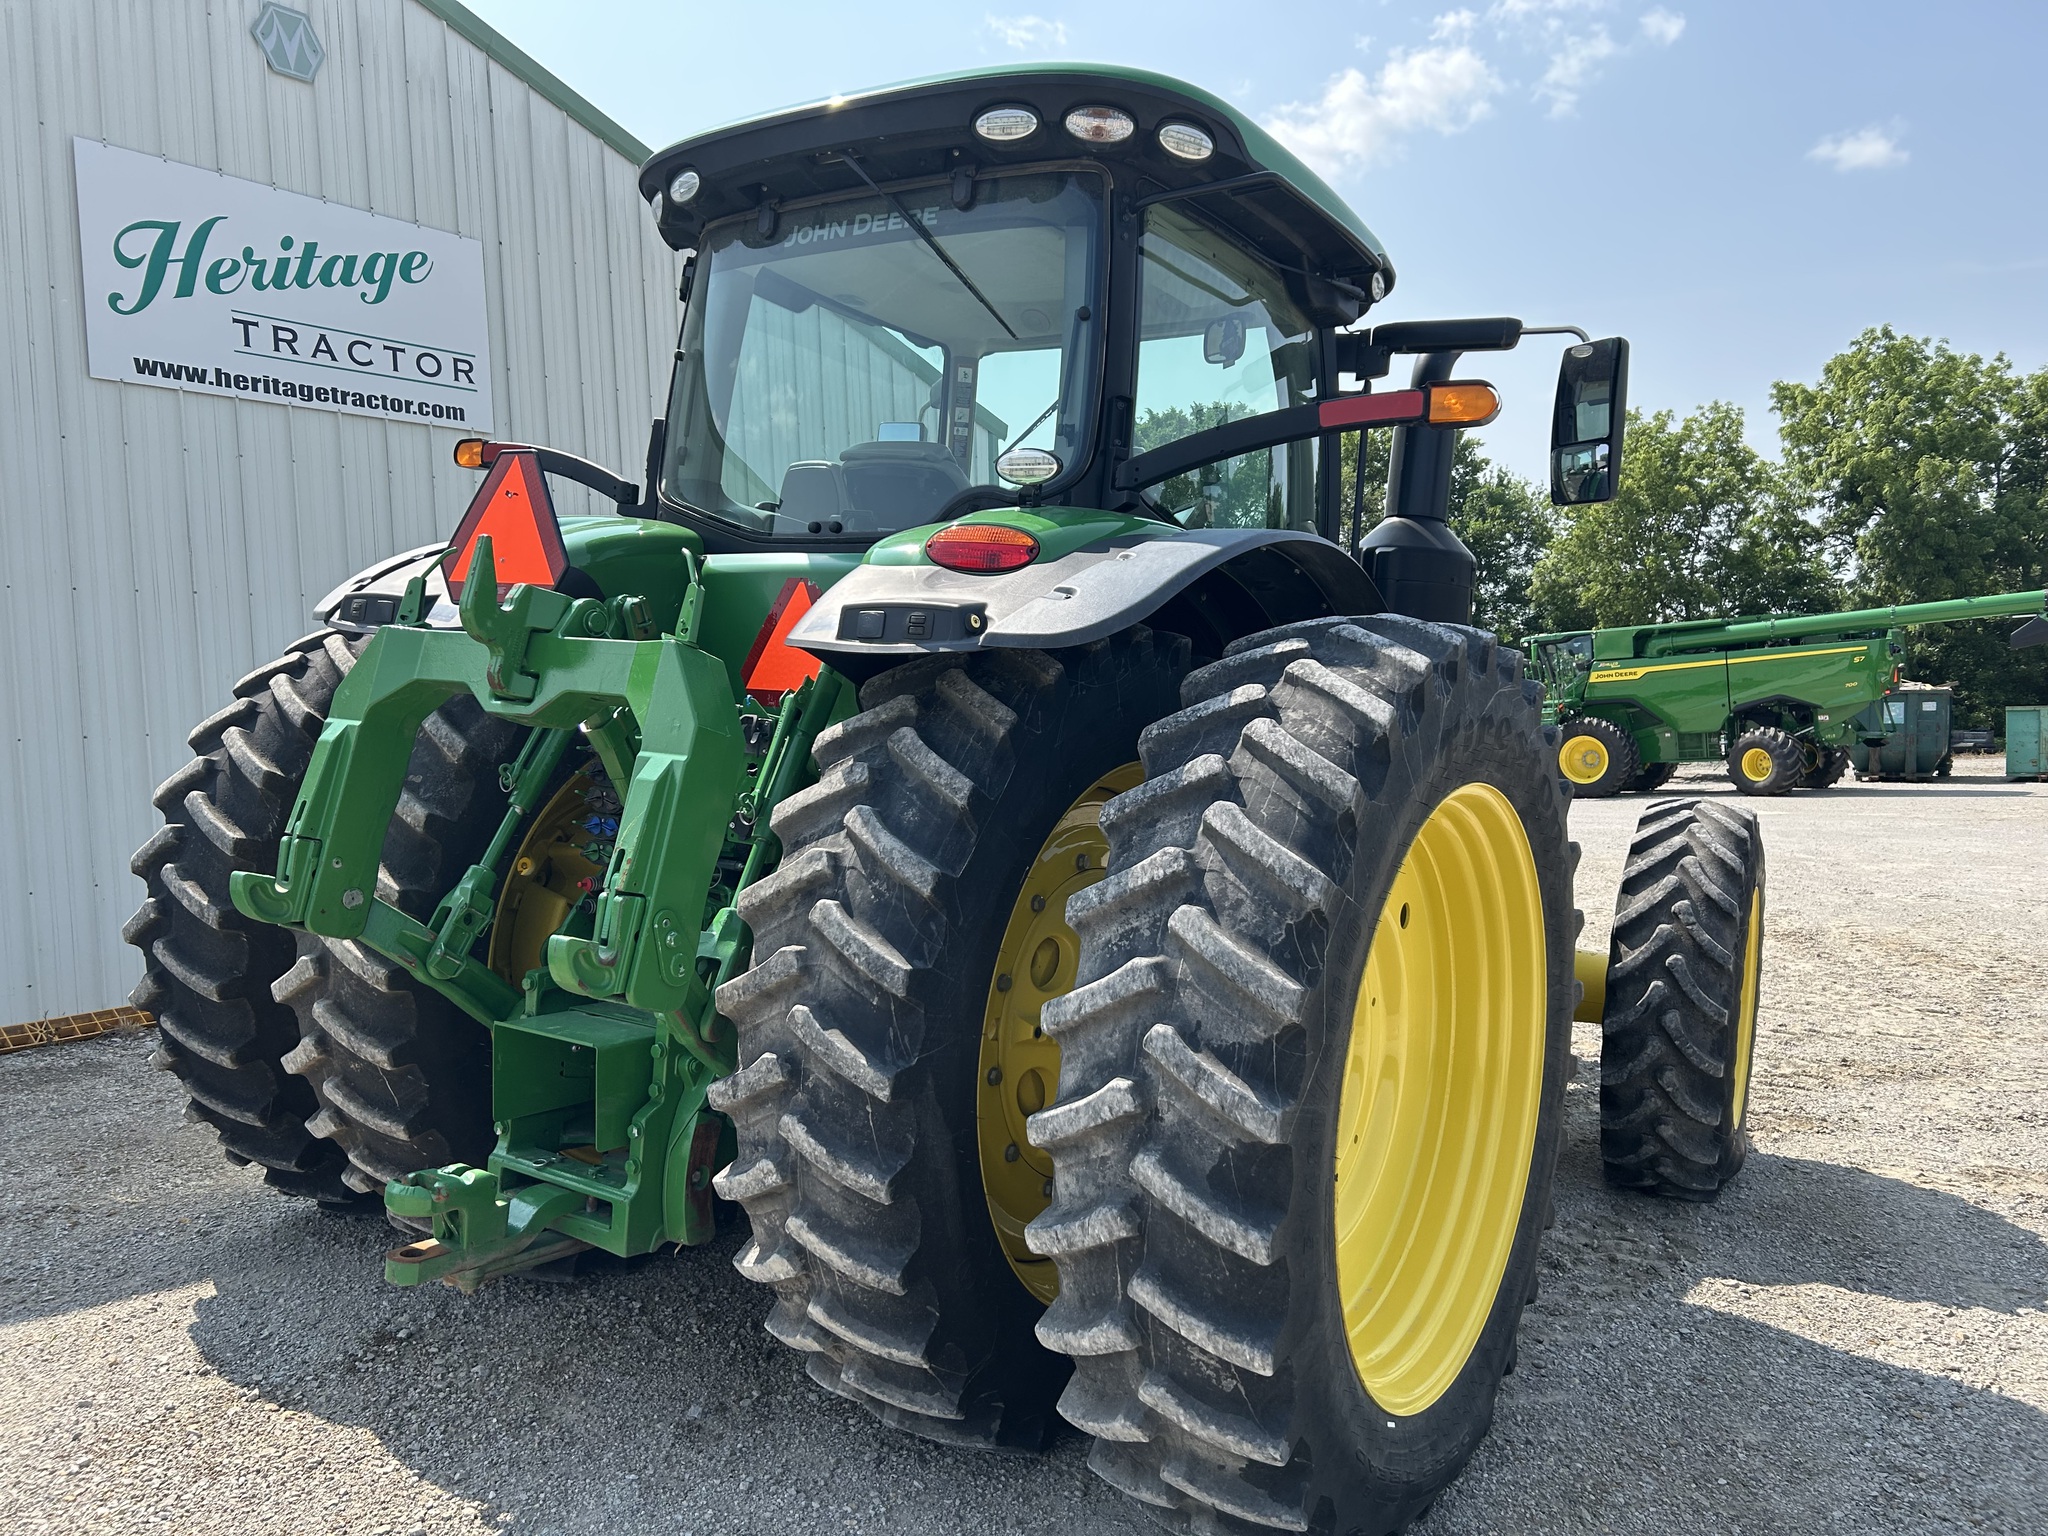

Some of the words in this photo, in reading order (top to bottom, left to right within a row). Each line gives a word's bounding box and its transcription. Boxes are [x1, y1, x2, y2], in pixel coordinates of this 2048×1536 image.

[107, 216, 434, 315] Heritage
[784, 218, 849, 248] JOHN
[232, 316, 476, 385] TRACTOR
[133, 357, 466, 422] www.heritagetractor.com
[1853, 655, 1866, 663] S7
